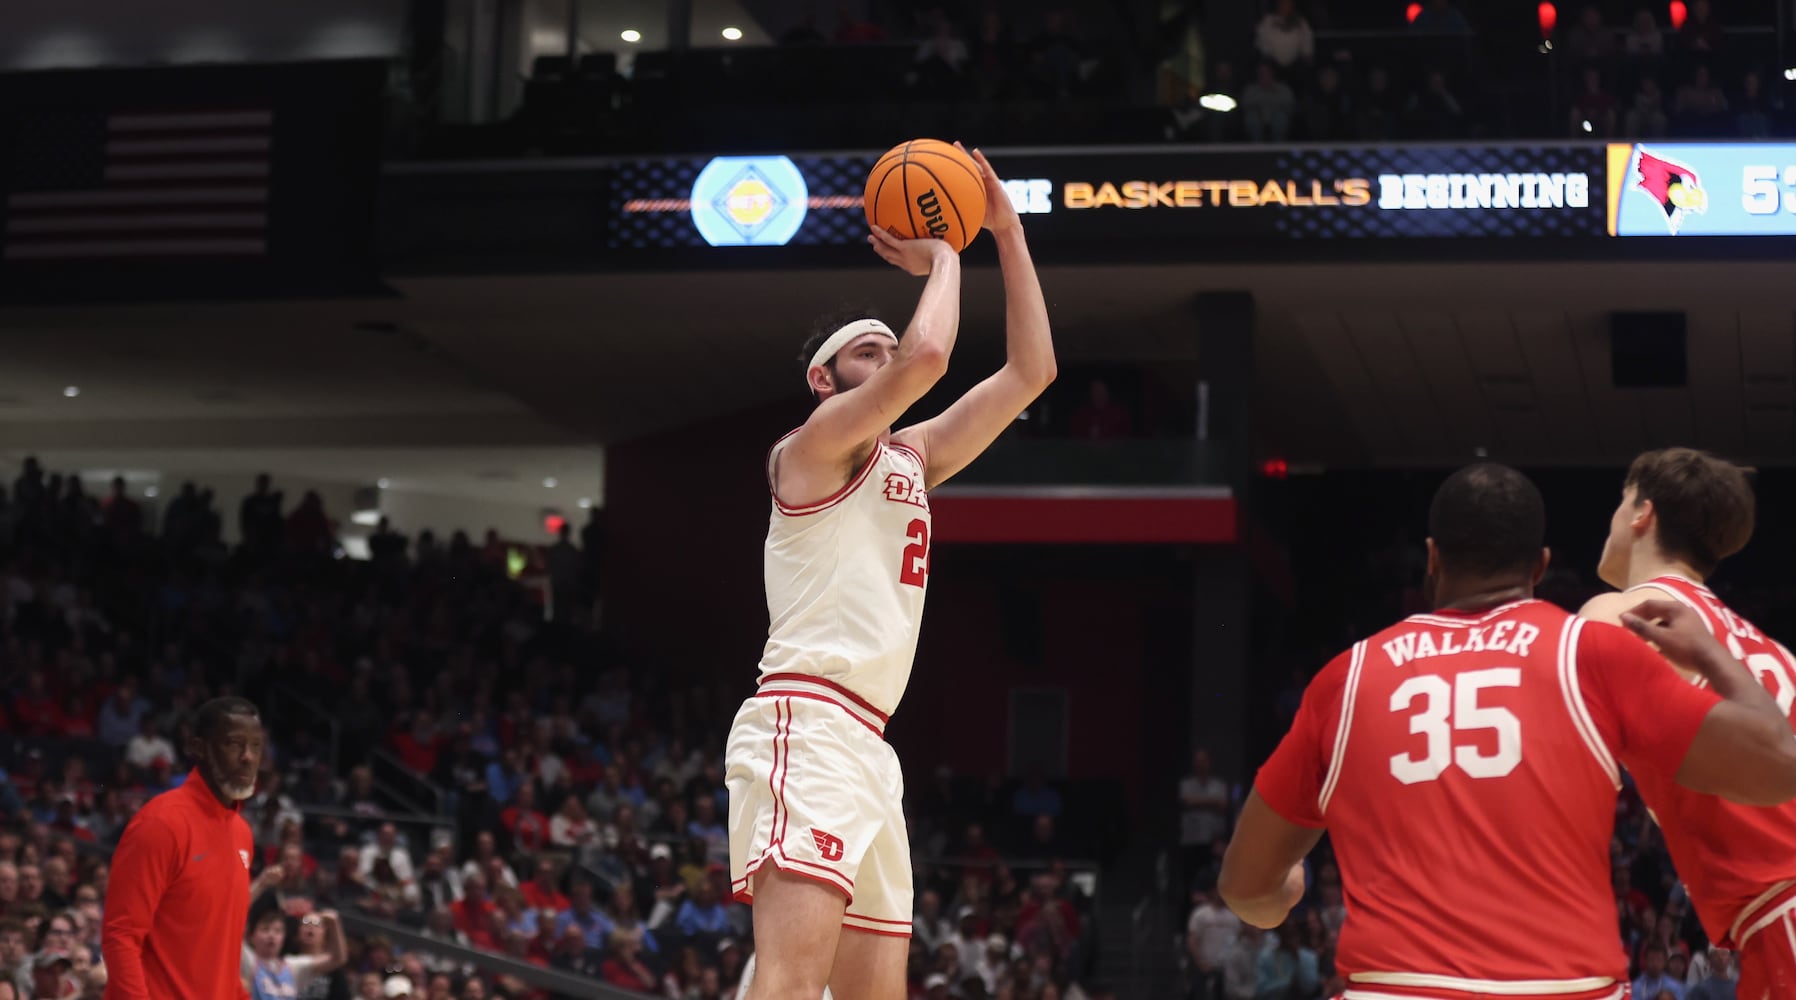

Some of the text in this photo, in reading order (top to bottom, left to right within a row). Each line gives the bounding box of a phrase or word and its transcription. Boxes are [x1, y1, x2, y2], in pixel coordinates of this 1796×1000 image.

[916, 188, 949, 240] Wil
[1064, 178, 1371, 209] BASKETBALL'S
[1378, 173, 1589, 210] BEGINNING
[900, 518, 930, 588] 2
[1382, 620, 1541, 668] WALKER
[1389, 667, 1522, 785] 35
